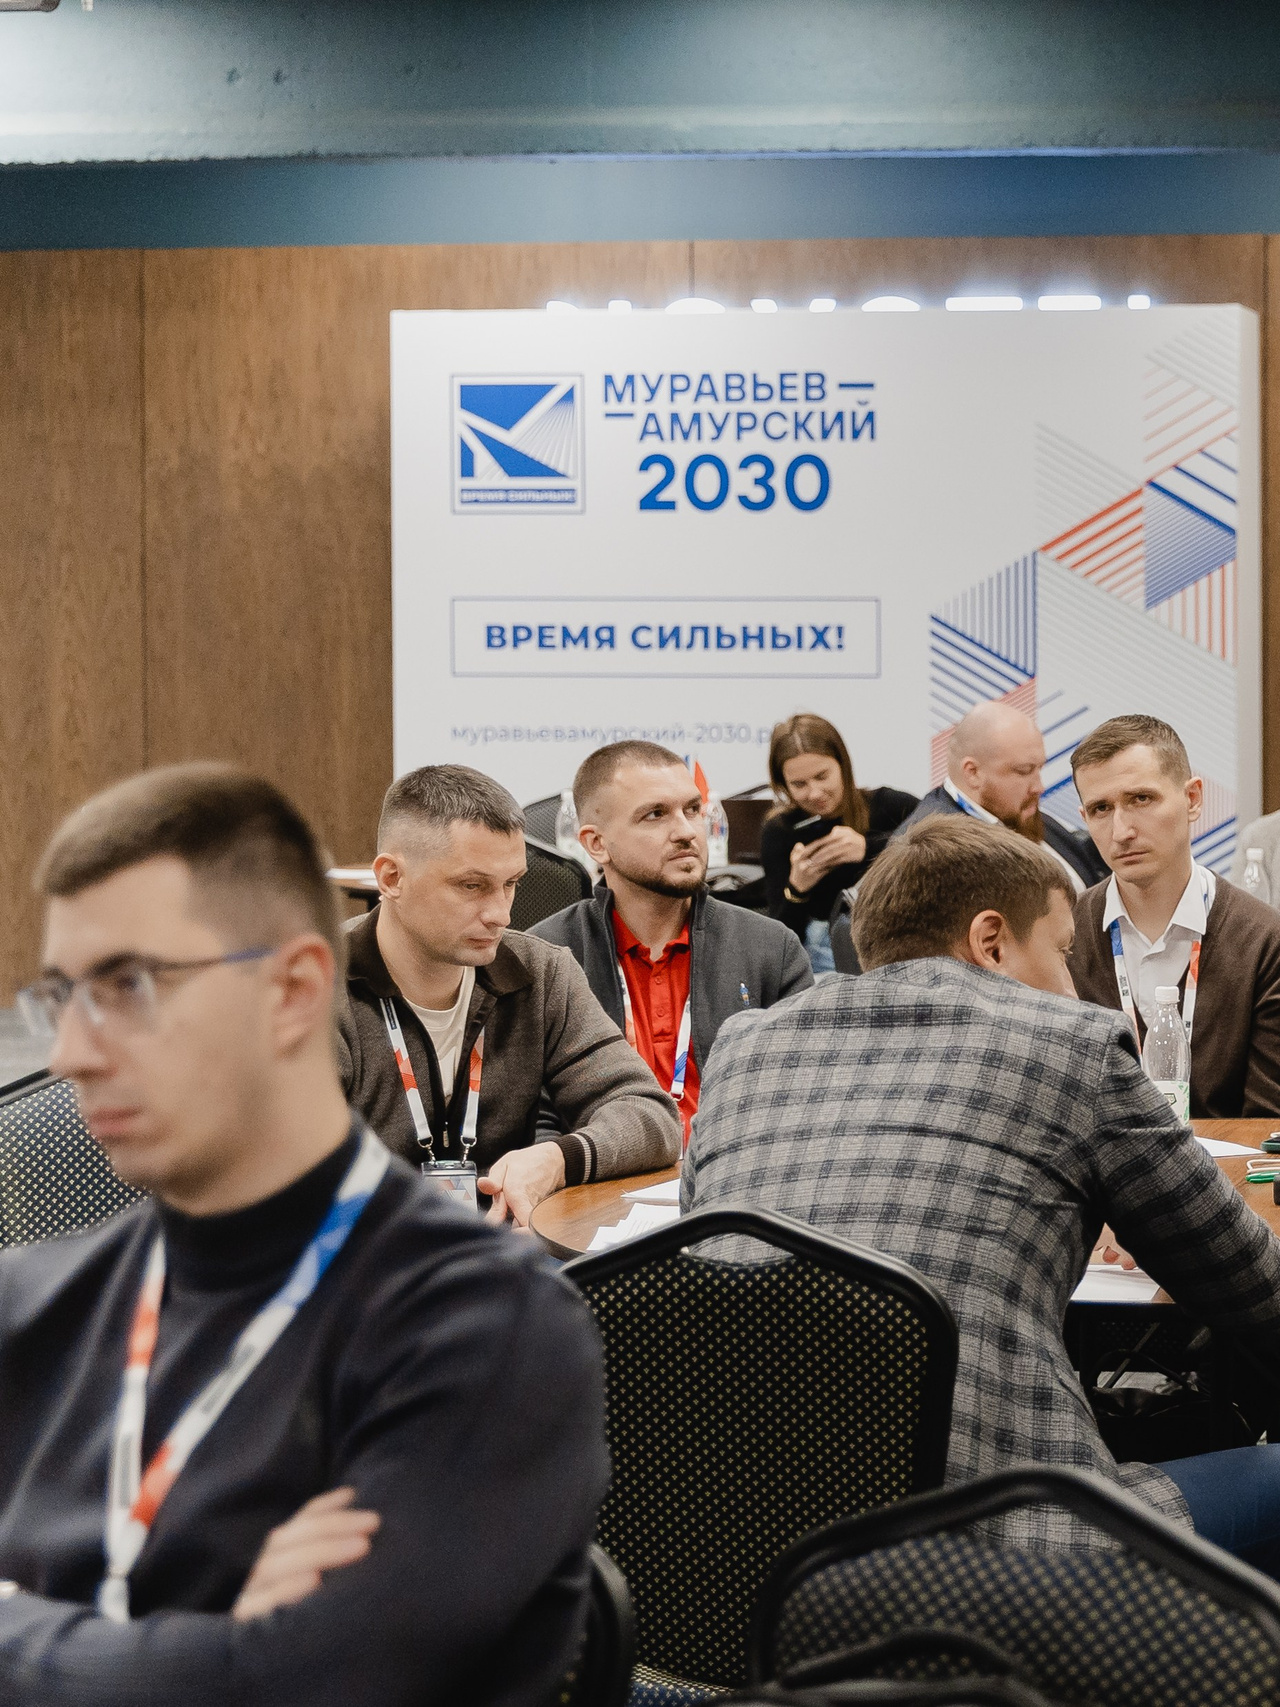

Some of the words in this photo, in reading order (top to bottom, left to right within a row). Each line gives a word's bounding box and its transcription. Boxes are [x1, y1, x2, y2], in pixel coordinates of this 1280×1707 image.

[638, 453, 830, 511] 2030
[485, 624, 616, 649] ВРЕМЯ
[631, 624, 845, 650] СИЛЬНЫХ!
[450, 721, 772, 746] муравьевамурский-2030.р
